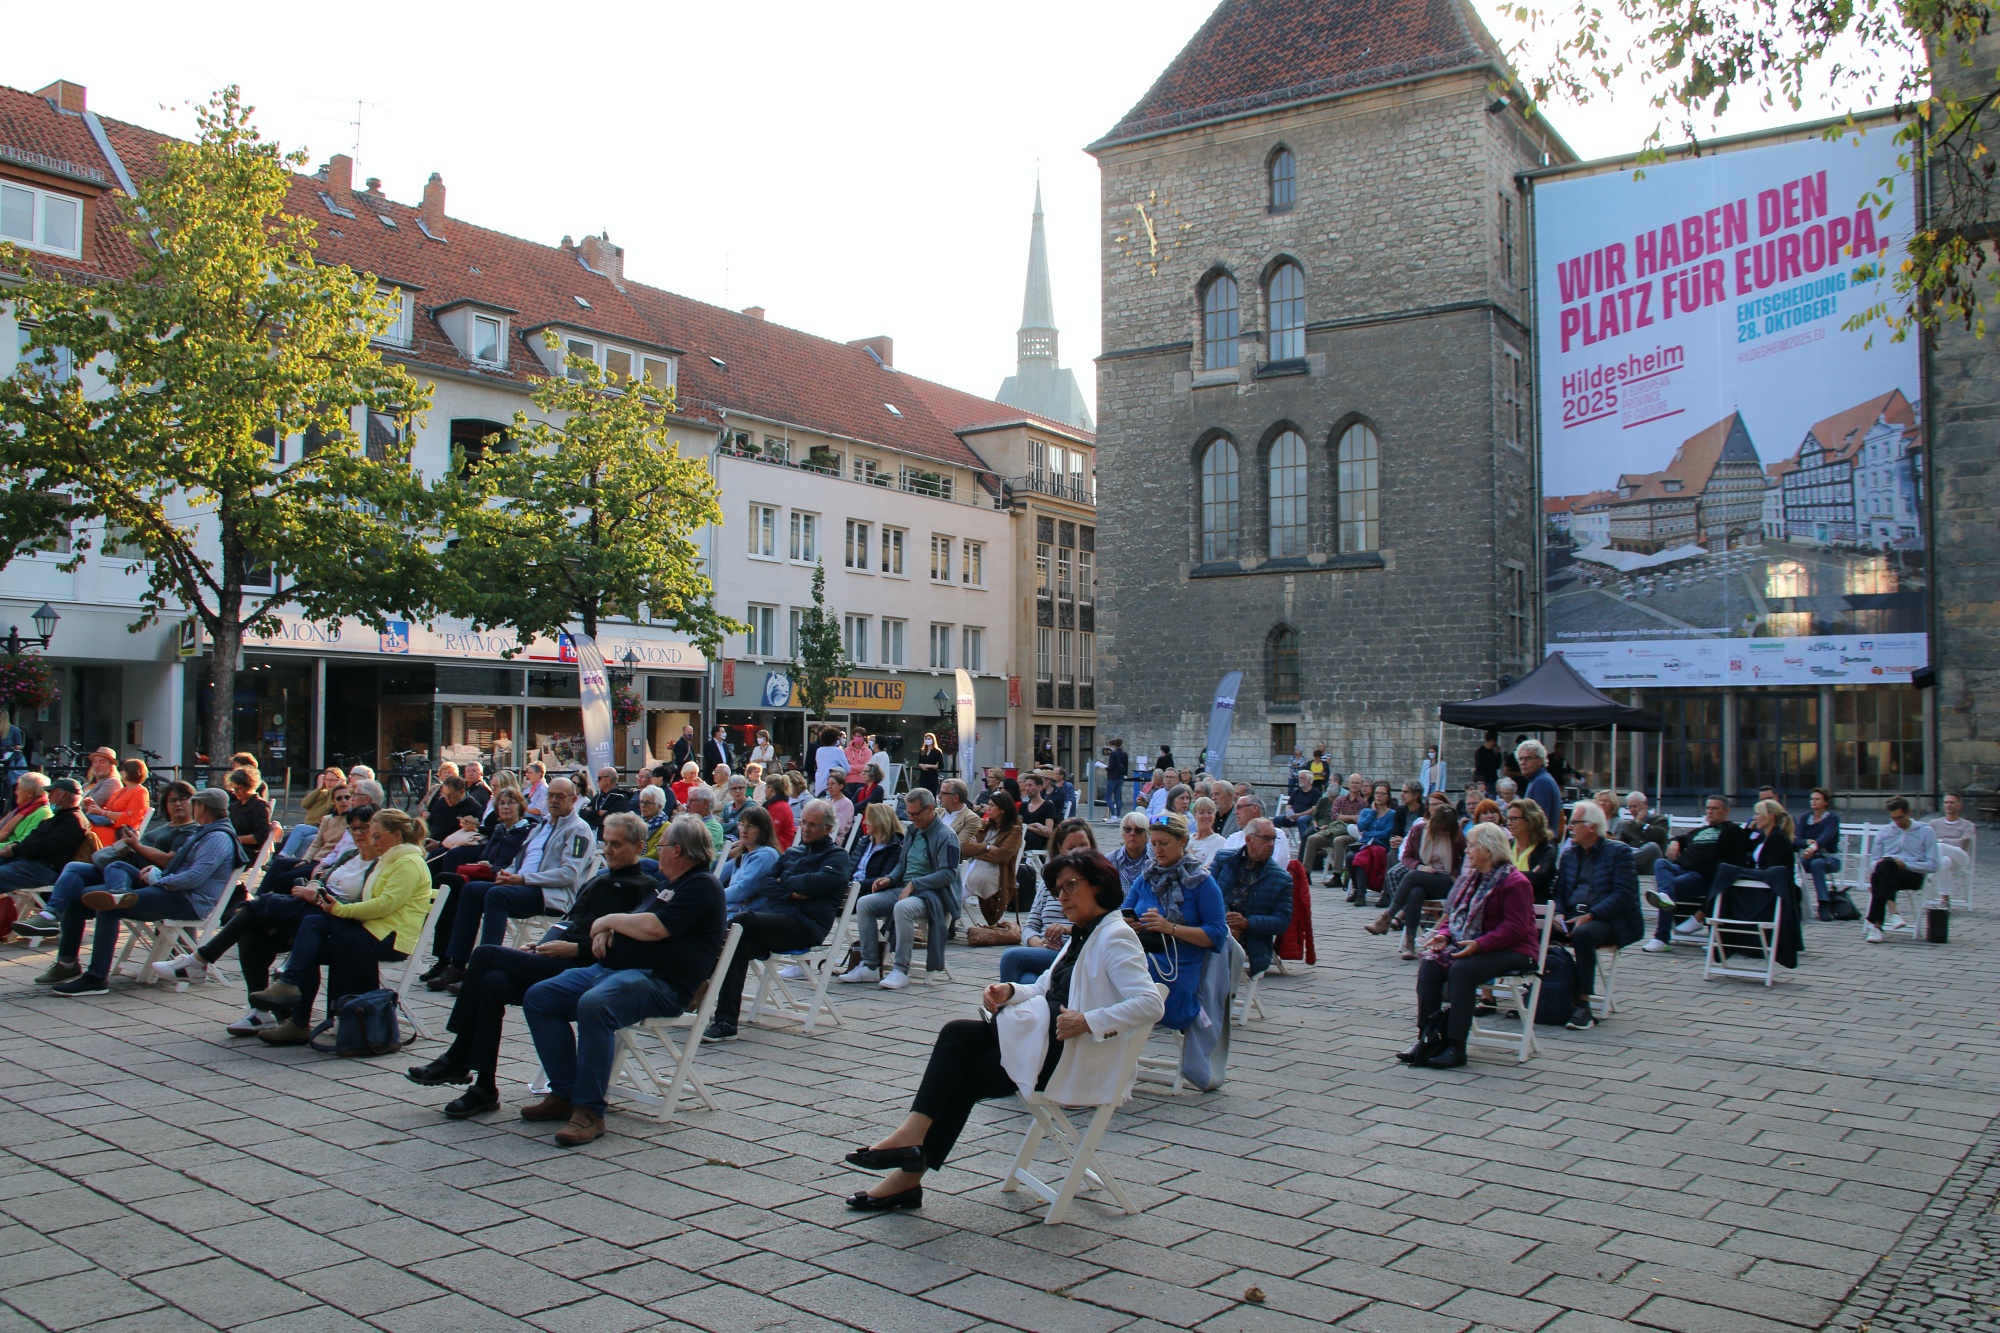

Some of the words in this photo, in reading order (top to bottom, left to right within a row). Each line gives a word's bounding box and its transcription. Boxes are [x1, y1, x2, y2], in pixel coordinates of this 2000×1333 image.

[1557, 242, 1627, 305] WIR
[1635, 197, 1749, 280] HABEN
[1757, 169, 1829, 238] DEN
[1560, 280, 1655, 354] PLATZ
[1662, 258, 1727, 321] FÜR
[1734, 207, 1890, 297] EUROPA.
[1737, 272, 1846, 323] ENTSCHEIDUNG
[1738, 320, 1762, 343] 28.
[1765, 295, 1838, 335] OKTOBER!
[1737, 326, 1826, 364] HILDESHEIM2025.EU
[1561, 344, 1684, 399] Hildesheim
[1629, 374, 1671, 396] EUROPEAN
[1562, 385, 1618, 422] 2025
[1622, 389, 1661, 411] PROVINCE
[1634, 399, 1668, 420] CULTURE
